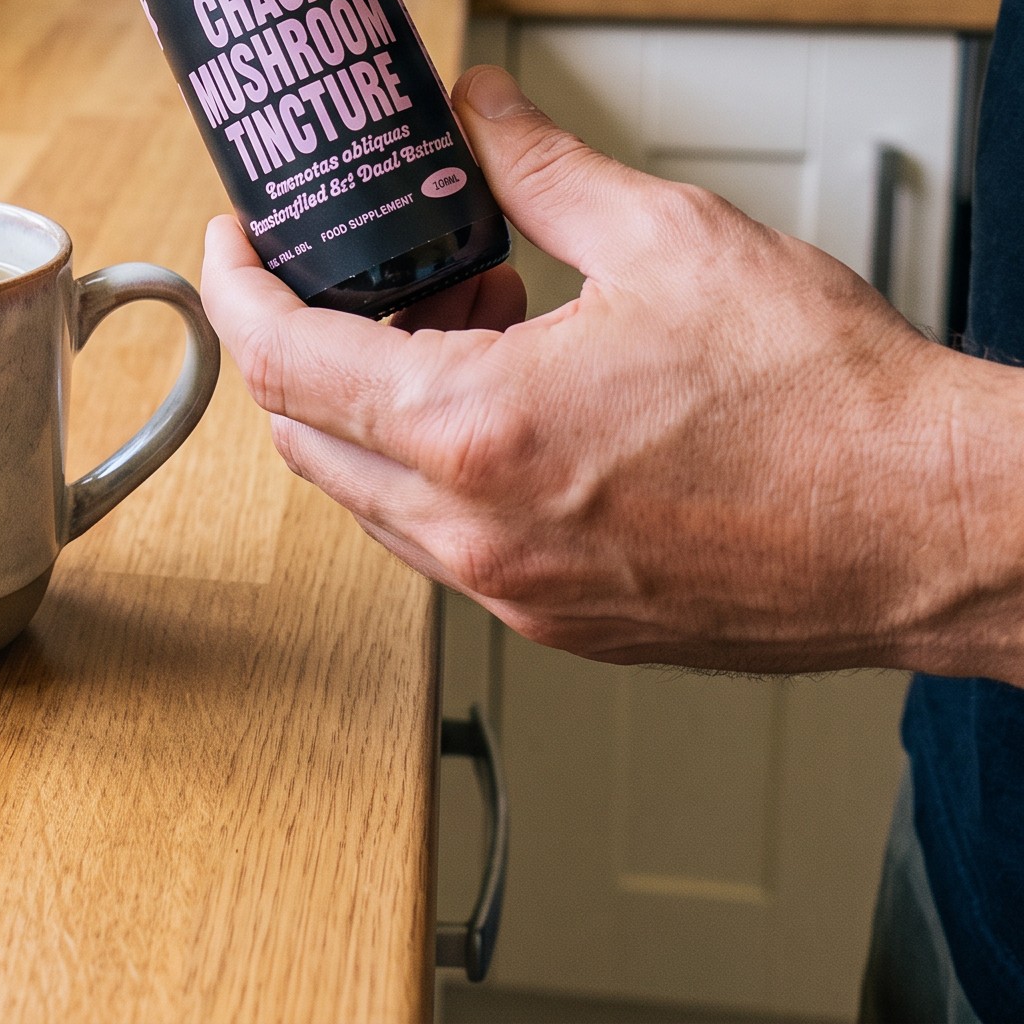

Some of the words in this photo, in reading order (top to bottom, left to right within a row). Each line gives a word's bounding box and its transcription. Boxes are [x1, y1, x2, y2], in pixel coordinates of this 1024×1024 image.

[224, 51, 413, 182] TINCTURE
[320, 223, 349, 243] FOOD
[348, 192, 414, 231] SUPPLEMENT
